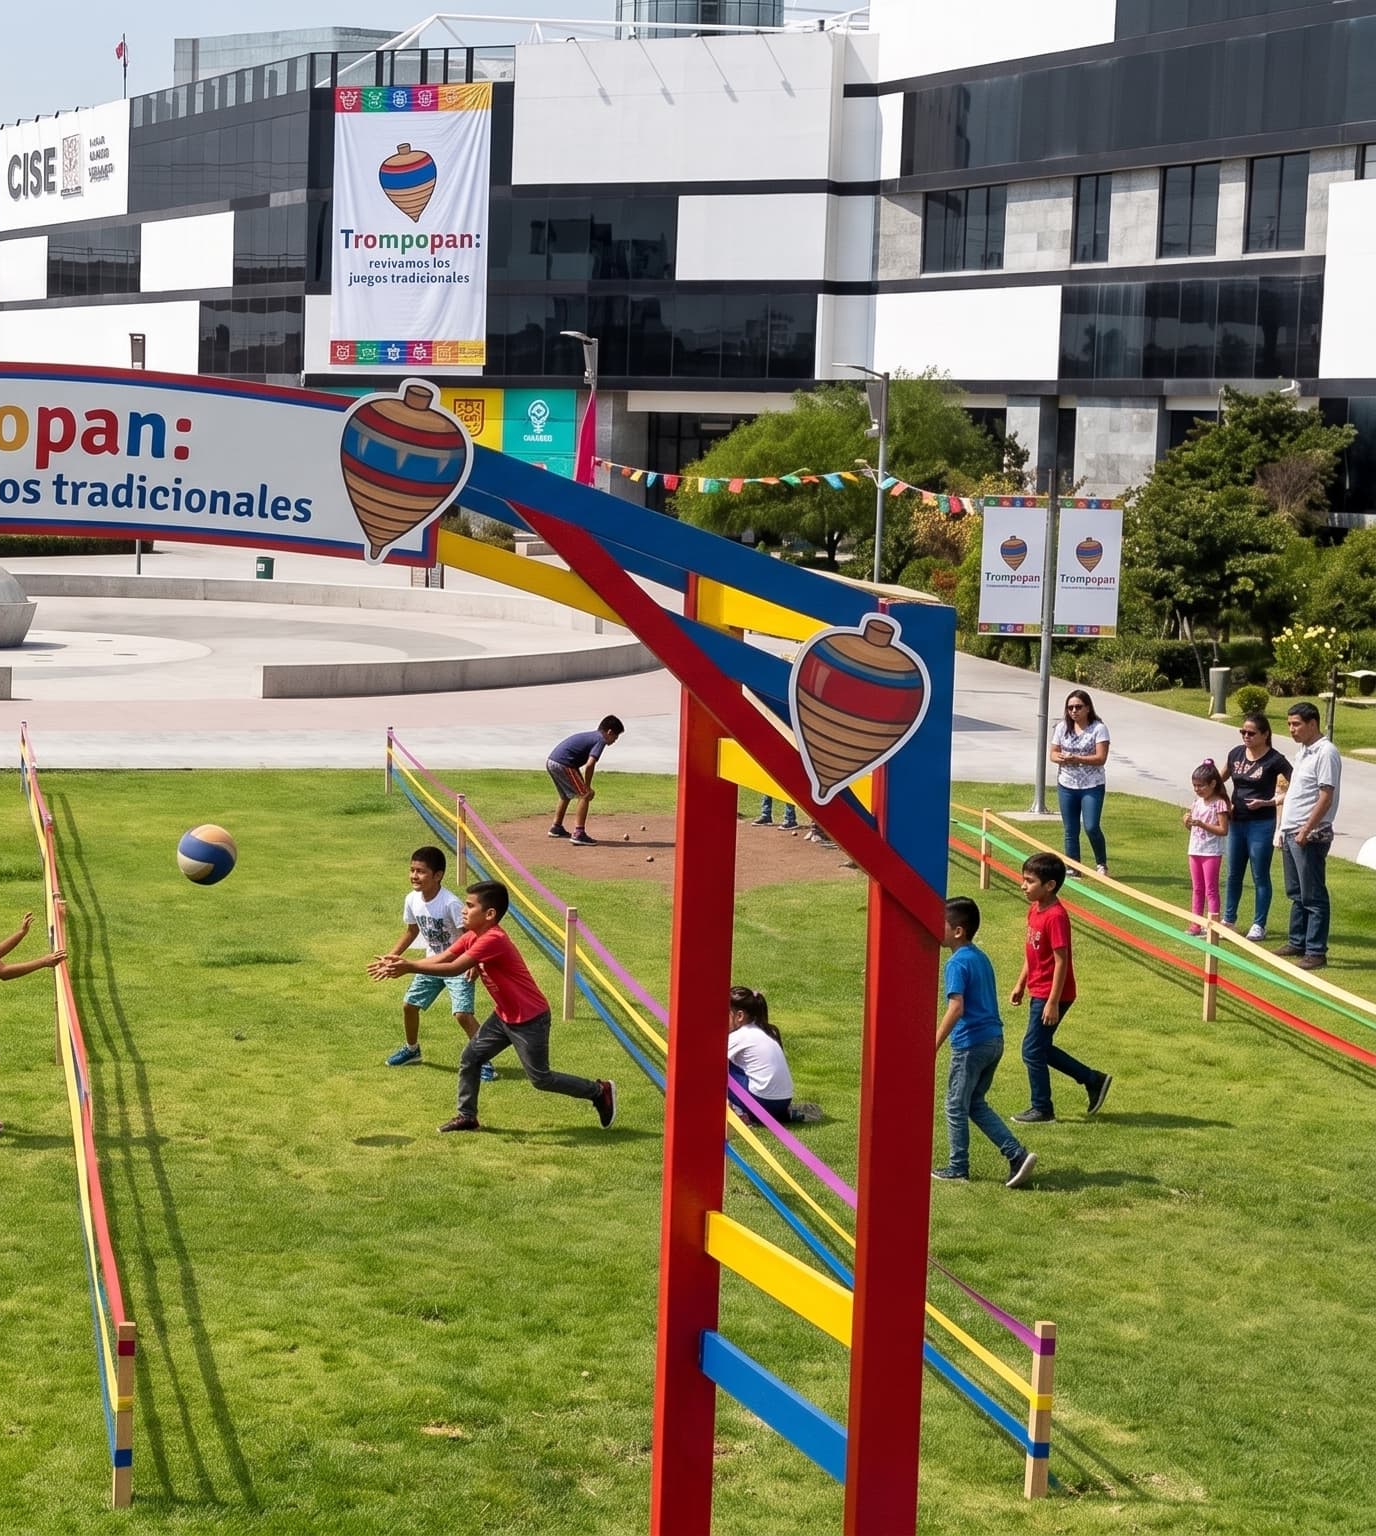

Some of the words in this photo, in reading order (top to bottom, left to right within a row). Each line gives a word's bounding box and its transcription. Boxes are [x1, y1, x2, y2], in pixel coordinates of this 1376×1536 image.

[7, 147, 57, 200] CISE
[340, 229, 481, 255] Trompopan:
[369, 257, 430, 269] revivamos
[433, 257, 451, 269] los
[348, 272, 388, 287] juegos
[391, 271, 470, 284] tradicionales
[51, 473, 314, 524] tradicionales
[1060, 574, 1116, 586] Trompopan
